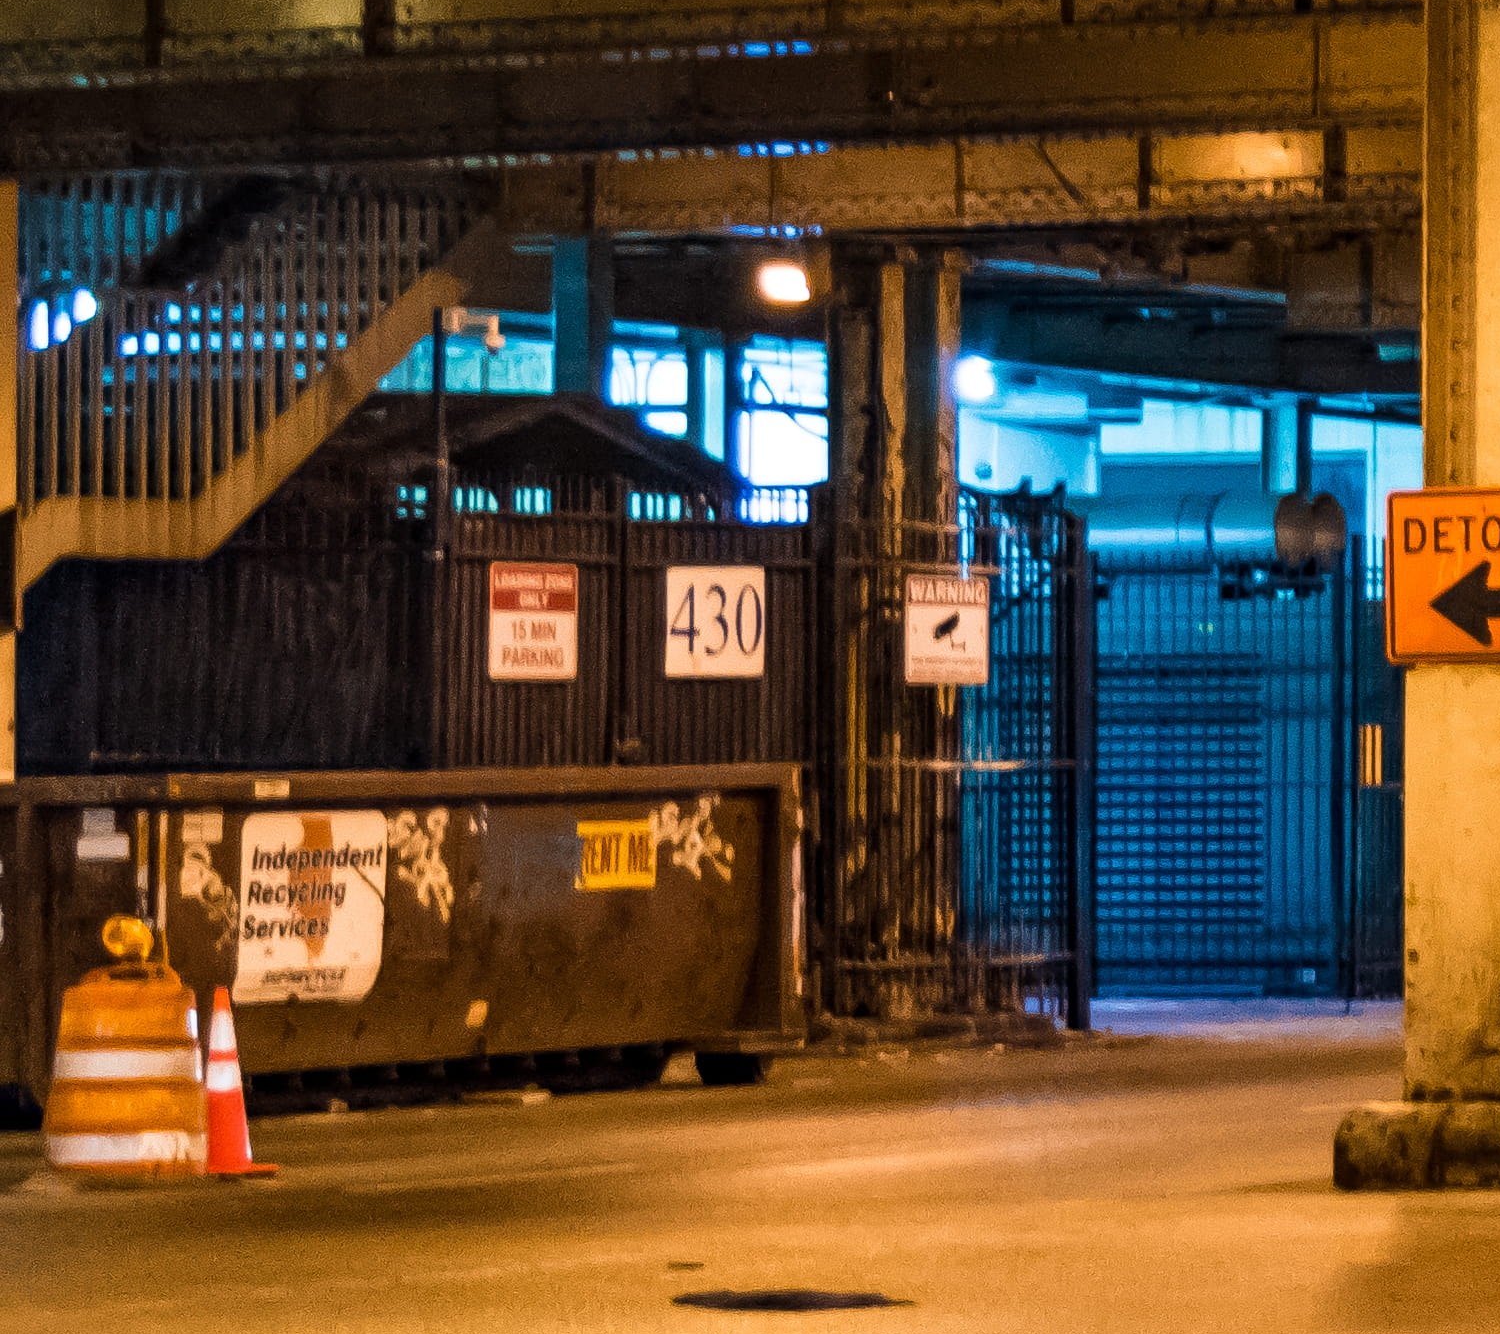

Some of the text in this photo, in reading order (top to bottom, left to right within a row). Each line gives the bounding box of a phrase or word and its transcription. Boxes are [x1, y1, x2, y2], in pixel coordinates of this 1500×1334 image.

[909, 577, 987, 603] WARNING
[510, 621, 557, 643] 15 MIN
[669, 582, 763, 657] 430
[501, 646, 565, 668] PARKING
[251, 841, 384, 871] Independent
[247, 879, 347, 909] Recycling
[242, 914, 330, 940] Services
